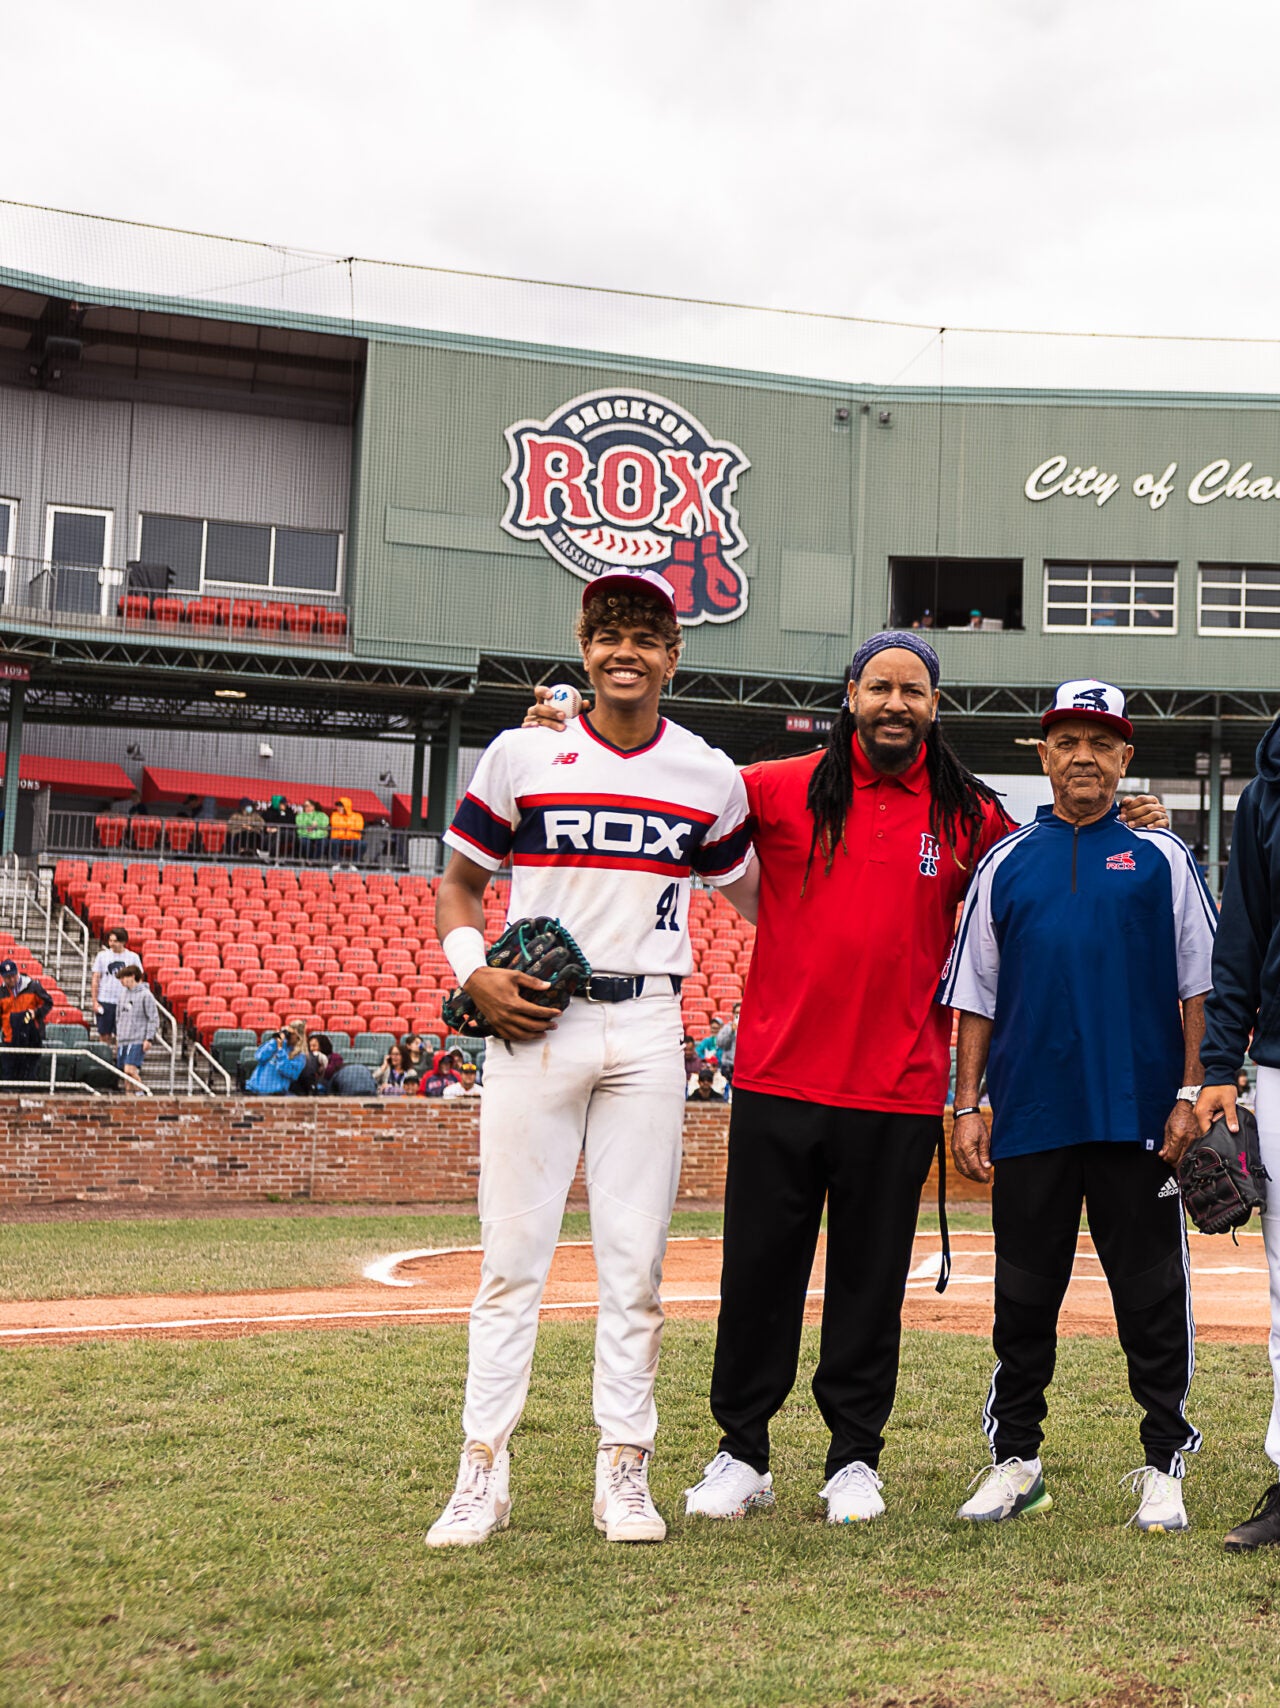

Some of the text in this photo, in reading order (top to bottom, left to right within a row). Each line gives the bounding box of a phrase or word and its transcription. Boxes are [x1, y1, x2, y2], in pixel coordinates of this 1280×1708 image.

[564, 400, 693, 445] BROCKTON
[520, 432, 735, 545] ROX
[1025, 455, 1120, 507] City
[1133, 462, 1178, 510] of
[543, 810, 692, 860] ROX
[1106, 862, 1136, 871] ROX
[655, 882, 681, 932] 41
